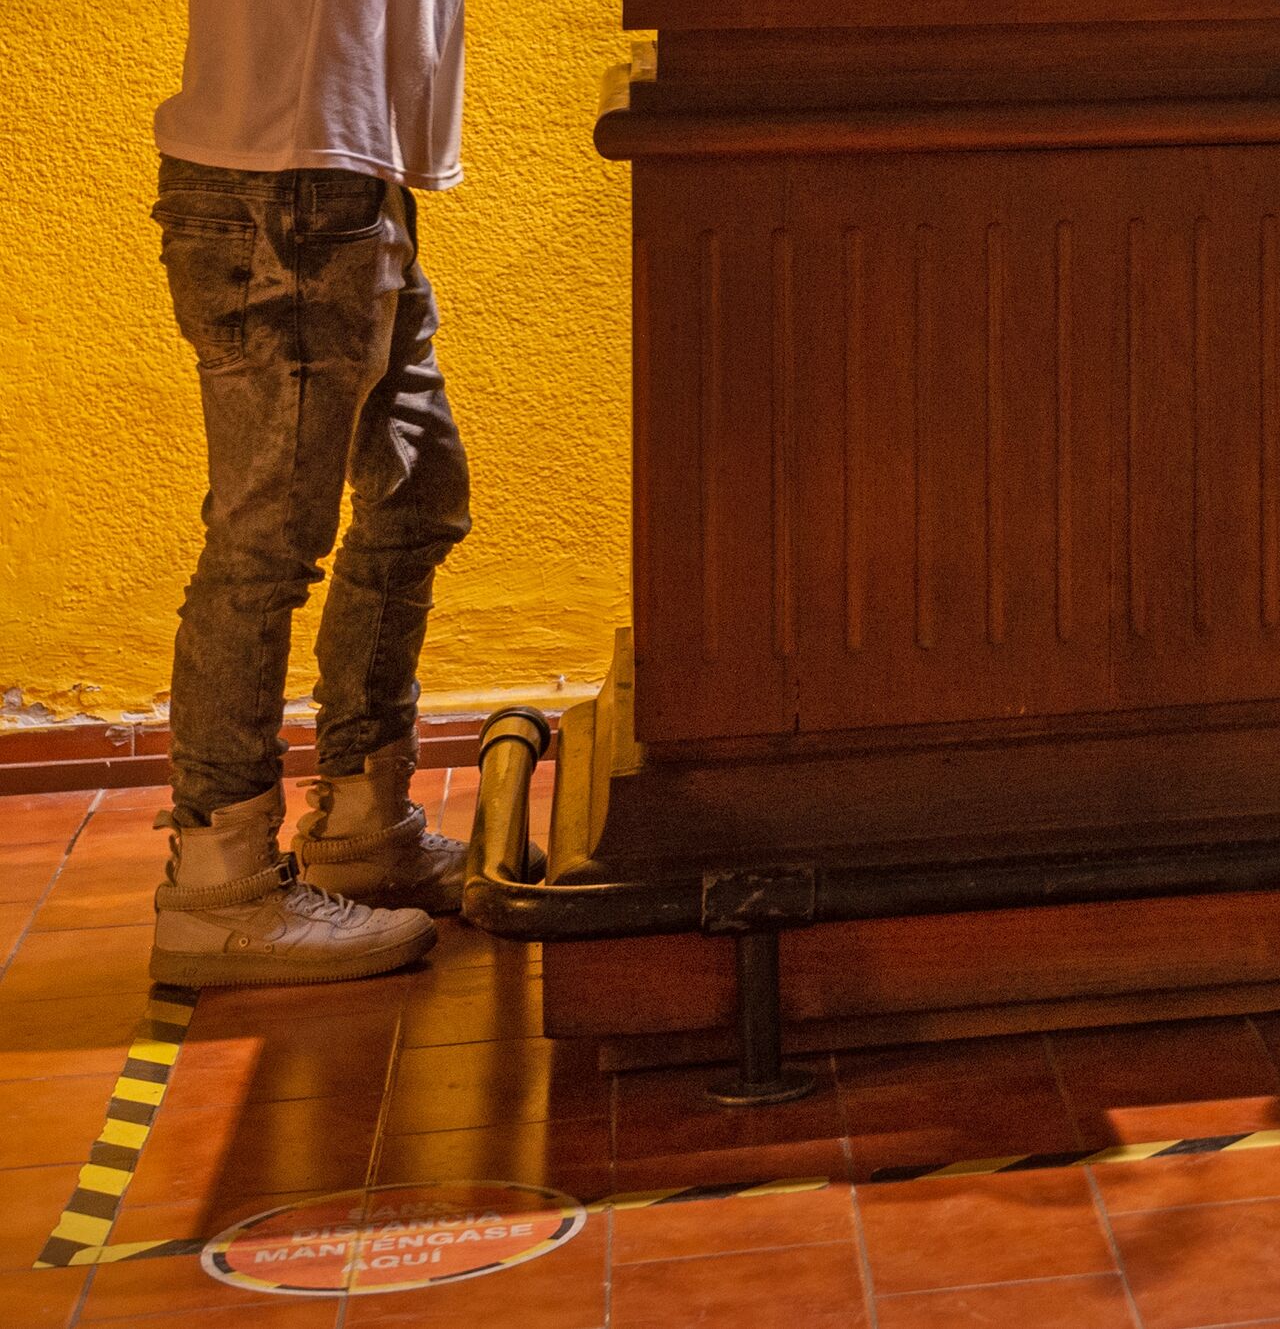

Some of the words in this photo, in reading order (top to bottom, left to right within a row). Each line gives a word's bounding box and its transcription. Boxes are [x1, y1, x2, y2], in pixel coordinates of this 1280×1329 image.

[291, 1210, 502, 1243] DISTANCIA
[254, 1223, 534, 1264] MANTÉNGASE
[341, 1247, 442, 1273] AQUÍ
